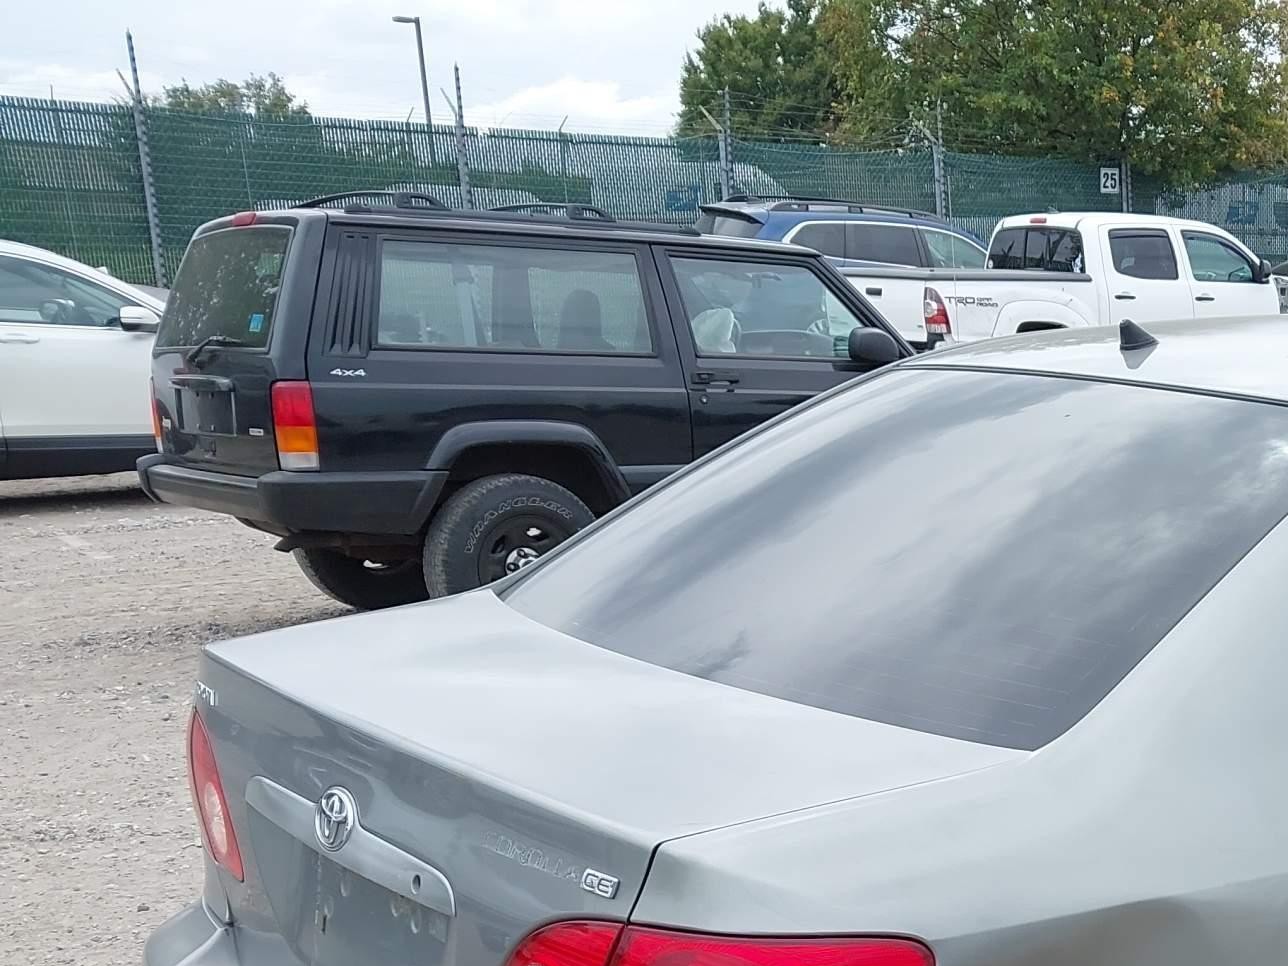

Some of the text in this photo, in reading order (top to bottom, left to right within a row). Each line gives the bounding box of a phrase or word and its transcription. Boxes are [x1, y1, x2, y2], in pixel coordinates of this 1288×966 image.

[1103, 172, 1117, 189] 25
[944, 296, 975, 306] TRD
[464, 497, 573, 553] WRANGLER
